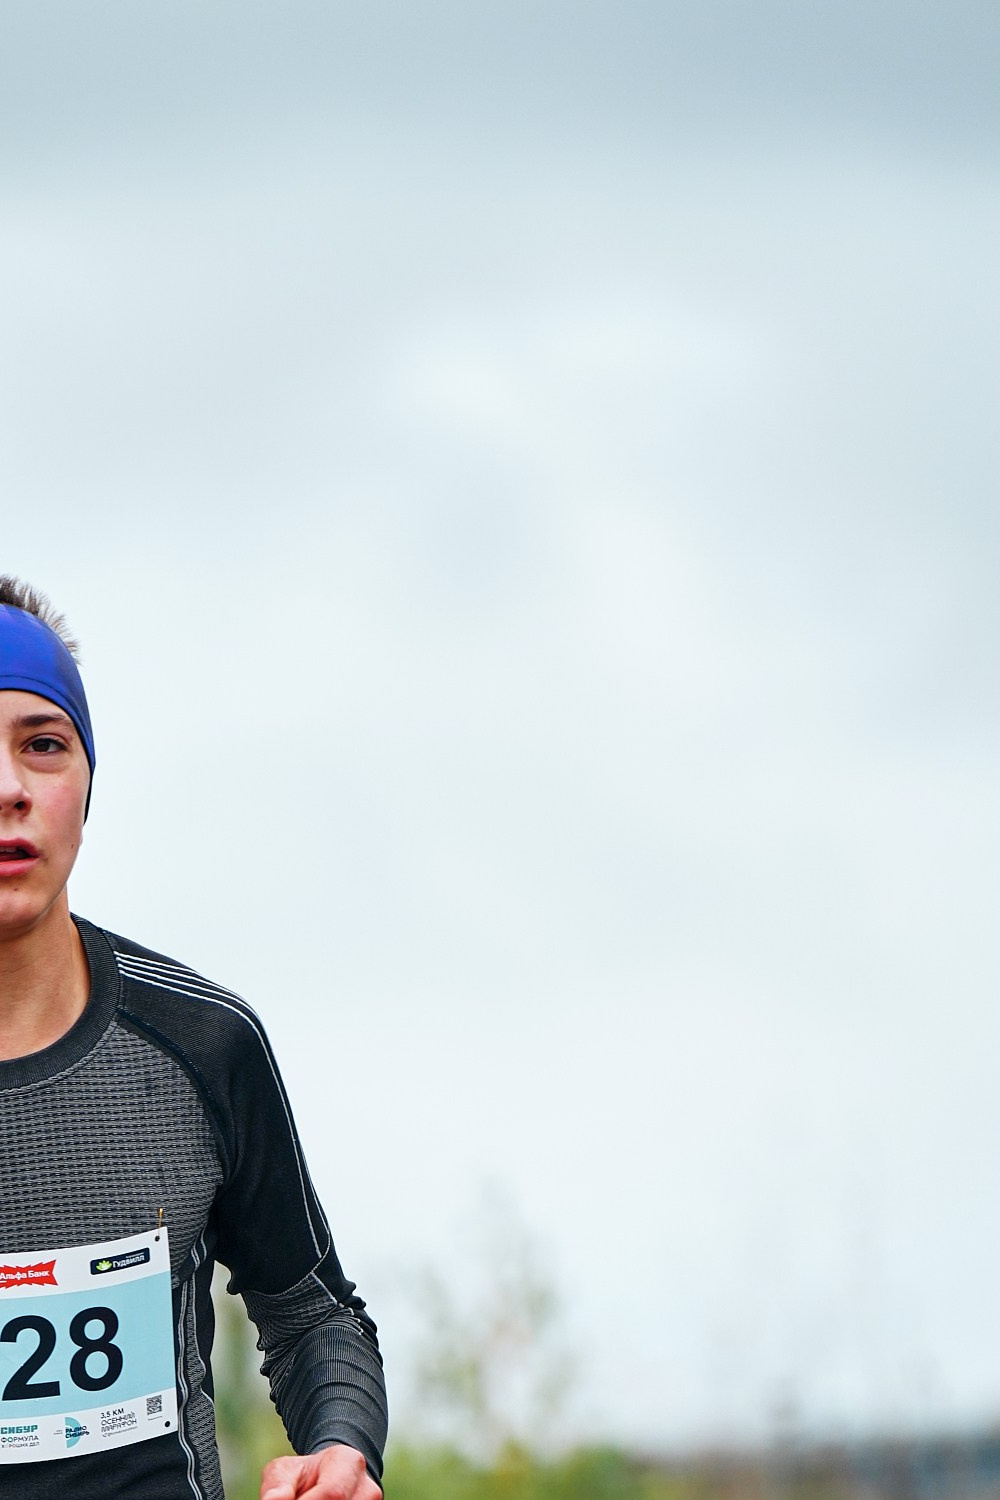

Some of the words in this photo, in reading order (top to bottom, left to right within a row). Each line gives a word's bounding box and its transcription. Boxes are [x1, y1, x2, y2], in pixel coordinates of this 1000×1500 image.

[0, 1271, 27, 1282] Альфа
[28, 1269, 50, 1279] Банк
[0, 1425, 38, 1434] СИБУР
[65, 1425, 87, 1434] РАДИО
[65, 1430, 90, 1438] СИБИРЬ
[0, 1435, 39, 1443] ФОРМУЛА
